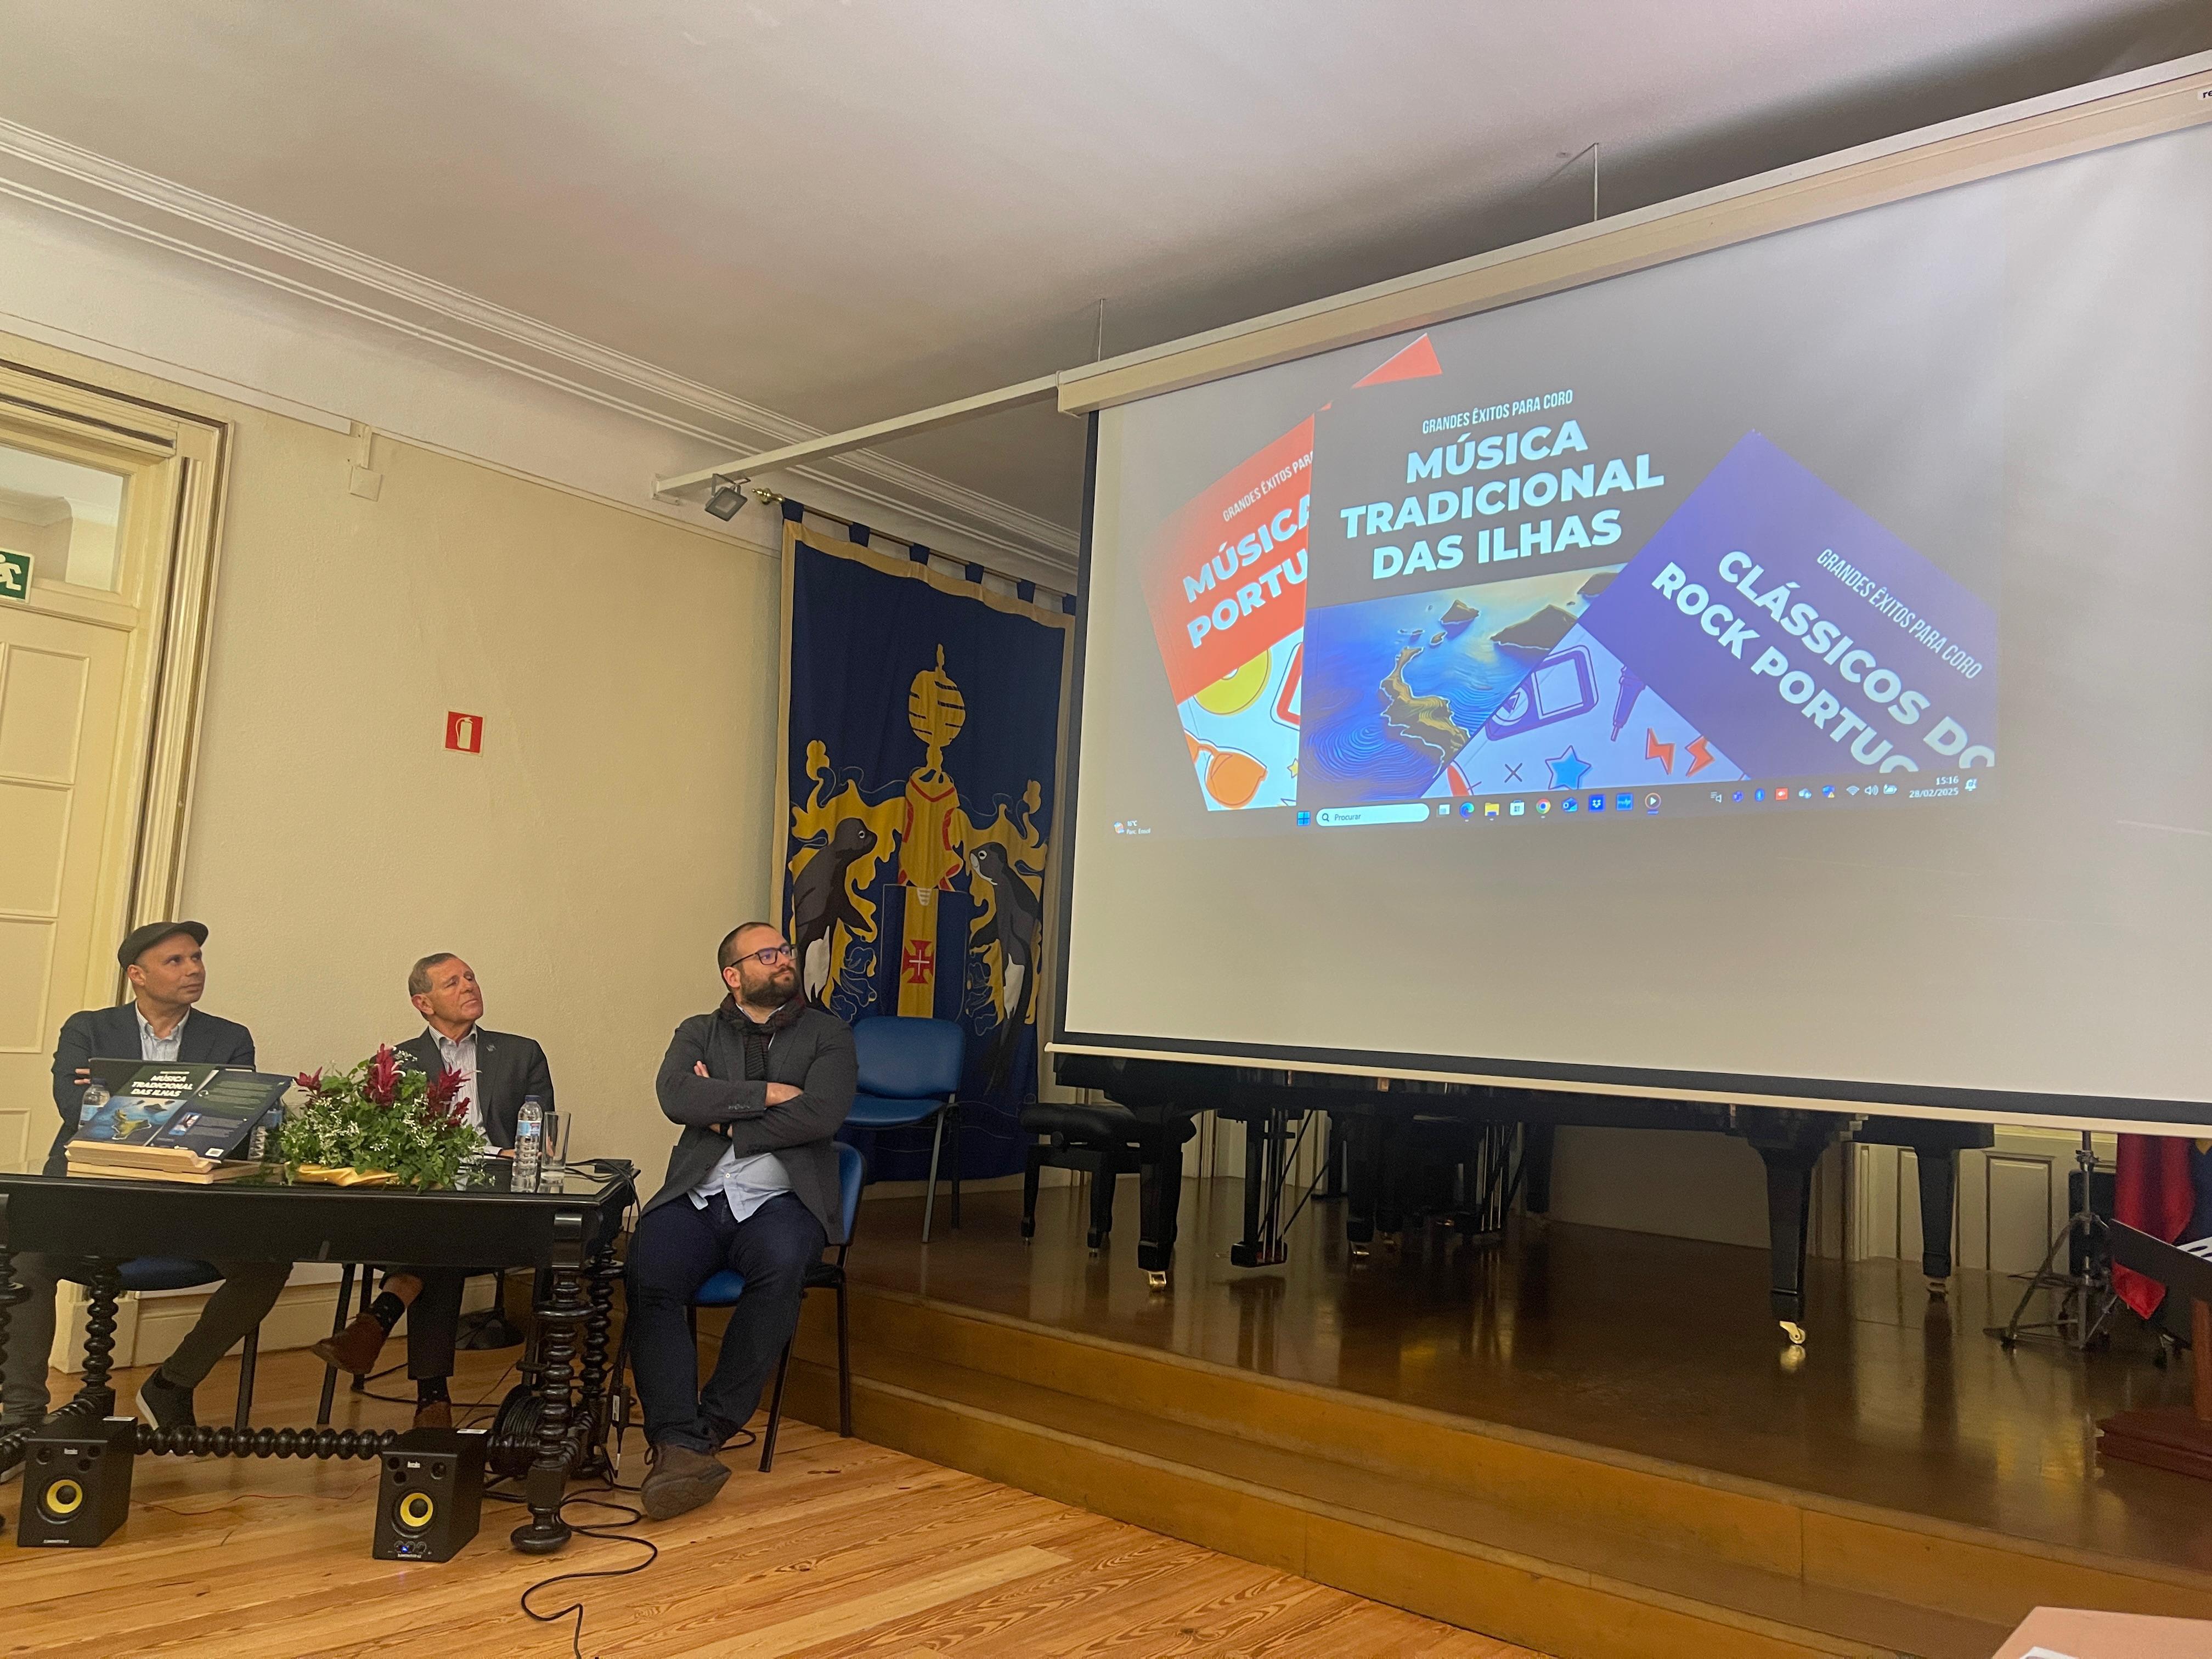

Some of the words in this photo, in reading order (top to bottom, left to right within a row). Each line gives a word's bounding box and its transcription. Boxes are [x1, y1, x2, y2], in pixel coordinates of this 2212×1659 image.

[1422, 411, 1470, 435] GRANDES
[1472, 403, 1510, 425] ÊXITOS
[1512, 397, 1541, 416] PARA
[1543, 389, 1574, 409] CORO
[1406, 420, 1588, 484] MÚSICA
[1222, 487, 1261, 522] GRANDES
[1260, 466, 1293, 495] ÊXITOS
[1340, 454, 1664, 539] TRADICIONAL
[1373, 534, 1464, 580] DAS
[1477, 509, 1622, 564] ILHAS
[1187, 548, 1308, 648] PORTU
[1651, 561, 1760, 659] ROCK
[1816, 549, 1876, 597] GRANDES
[1869, 586, 1916, 628] ÊXITOS
[1909, 619, 1948, 653] PARA
[1942, 645, 1983, 679] CORO
[1719, 551, 1931, 725] CLÁSSICOS
[1909, 787, 1959, 798] 28/02/2025
[1936, 776, 1959, 786] 15:16
[132, 1081, 193, 1090] TRADICIONAL
[150, 1074, 187, 1082] MÚSICA
